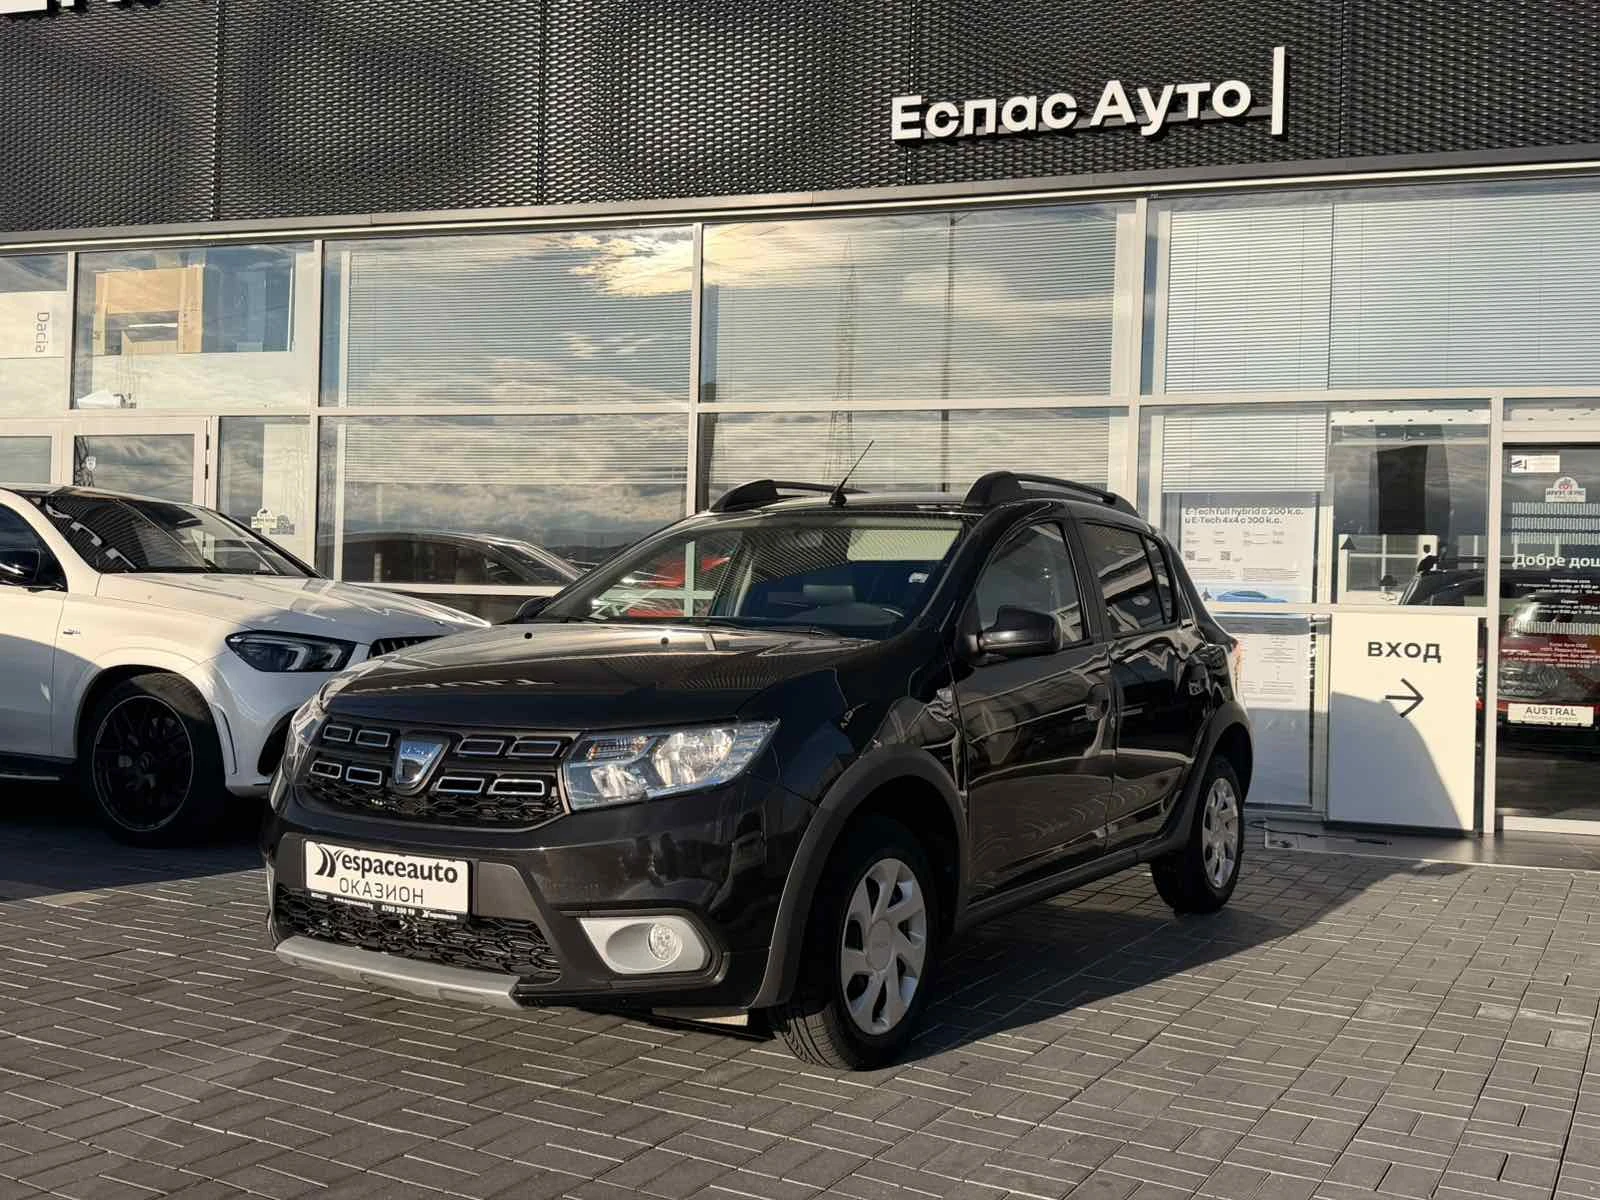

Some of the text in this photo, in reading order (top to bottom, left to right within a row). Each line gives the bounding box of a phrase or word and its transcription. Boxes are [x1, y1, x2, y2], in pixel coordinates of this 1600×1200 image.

[891, 79, 1252, 140] Еспас Ауто
[35, 312, 50, 353] Dacia
[1512, 553, 1566, 570] Добре
[1367, 641, 1442, 663] ВХОД
[1524, 706, 1577, 717] AUSTRAL
[341, 853, 458, 884] espaceauto
[338, 876, 425, 905] ОКАЗИОН
